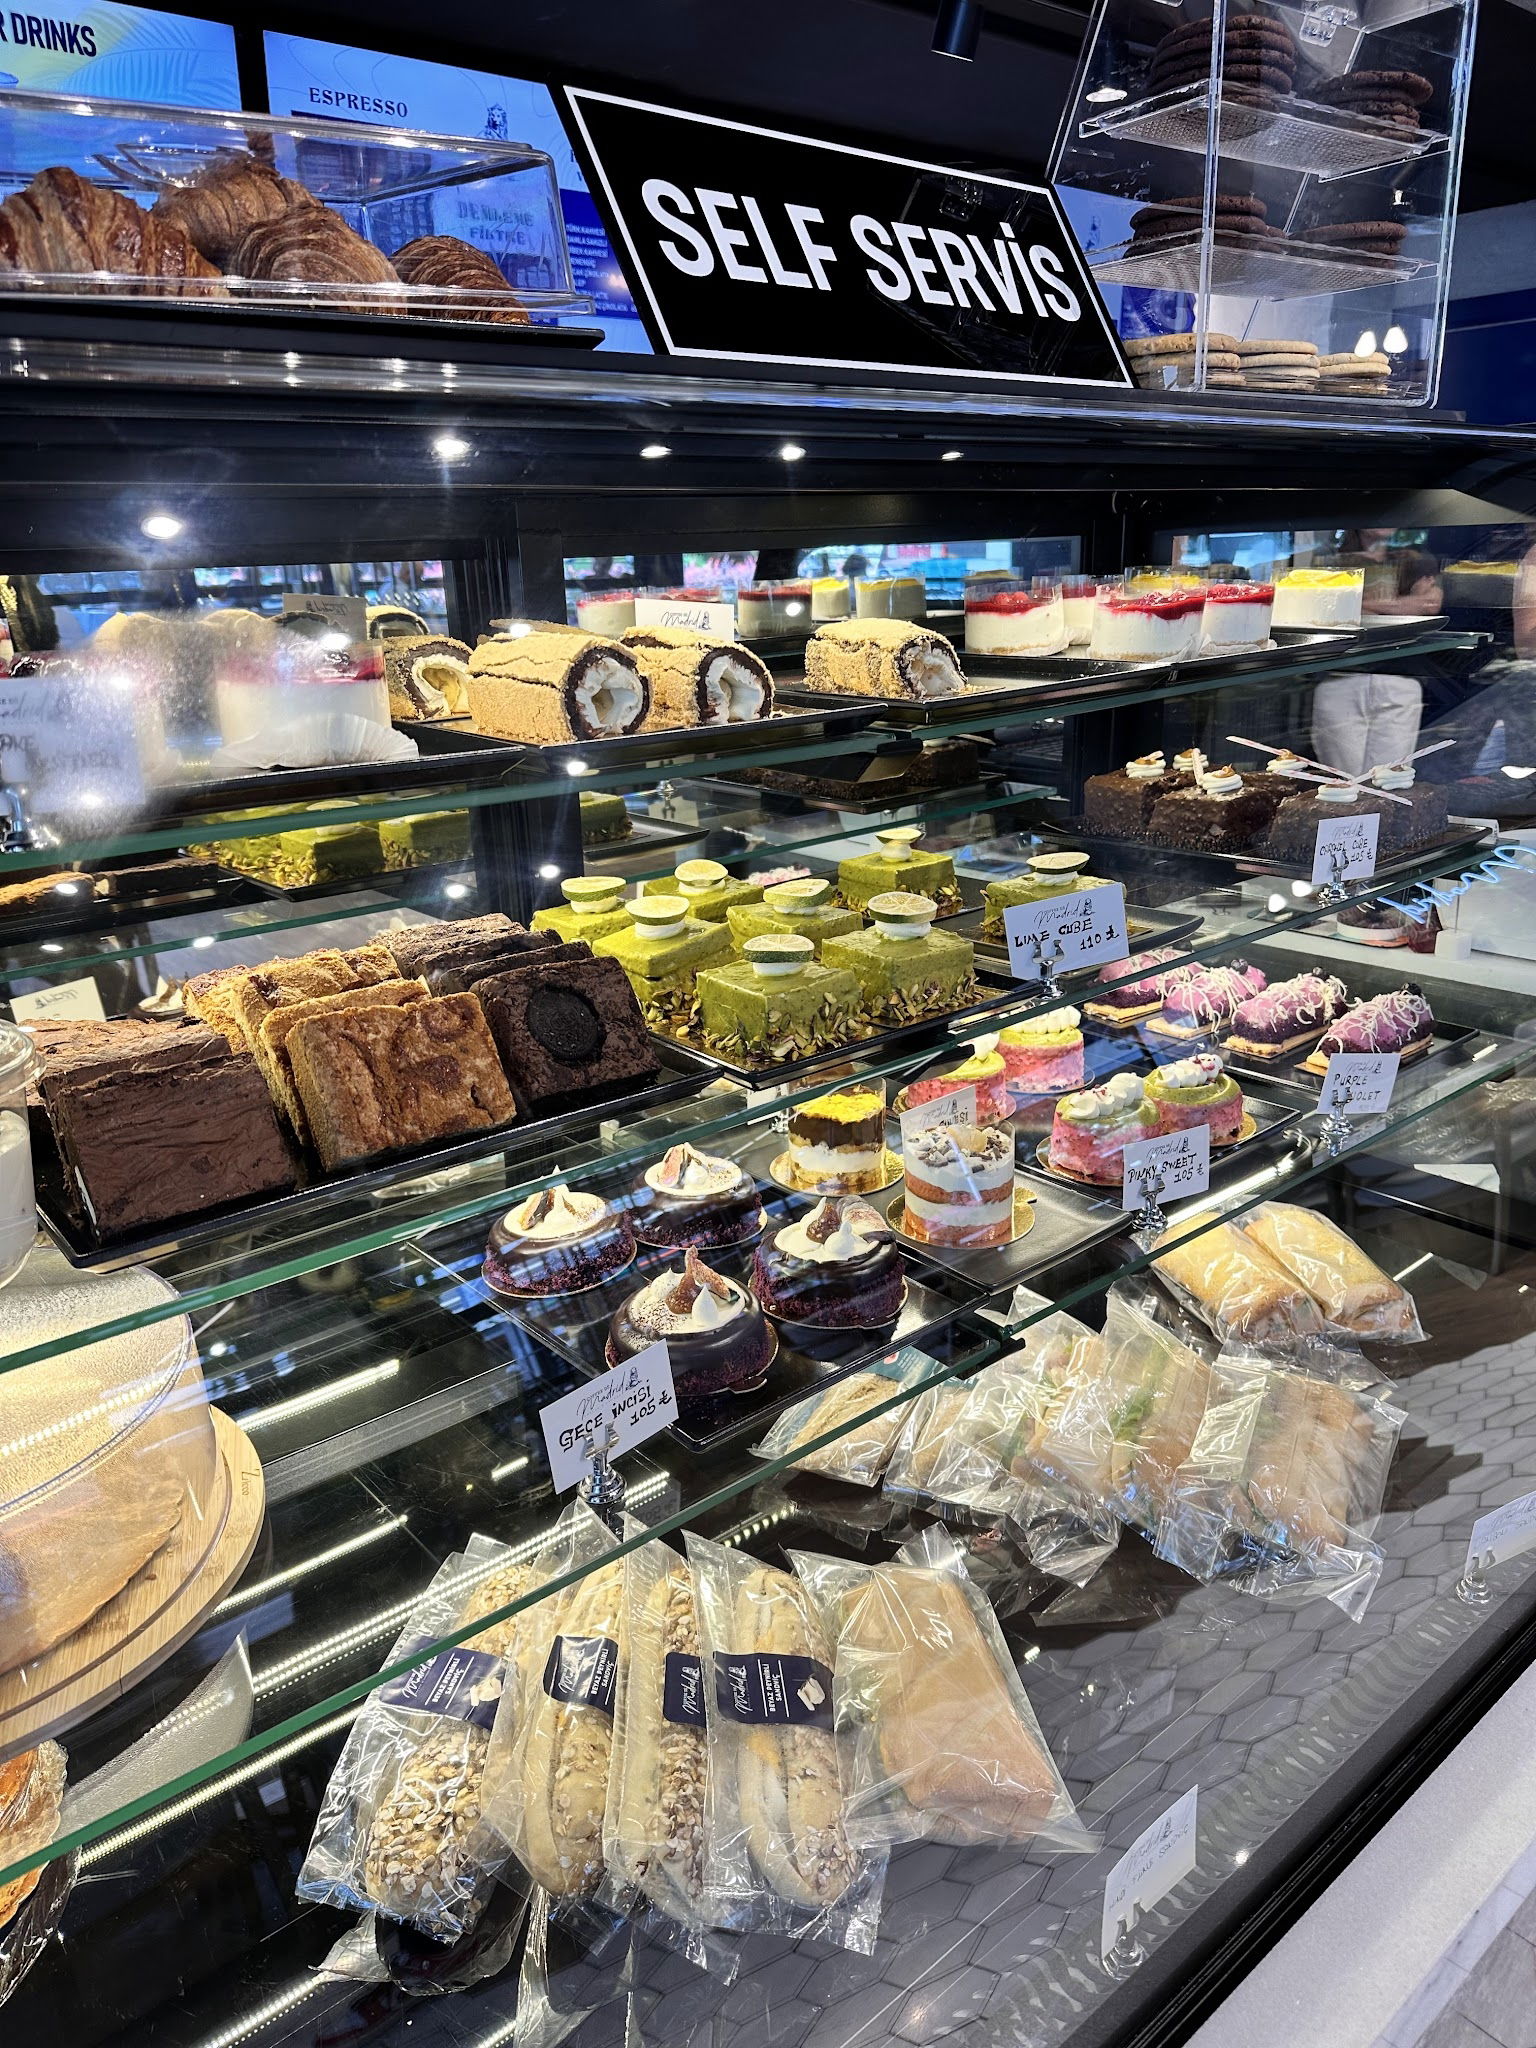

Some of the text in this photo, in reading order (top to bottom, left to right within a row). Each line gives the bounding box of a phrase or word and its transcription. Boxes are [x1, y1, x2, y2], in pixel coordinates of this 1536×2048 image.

[10, 12, 97, 57] DRINKS
[309, 87, 408, 118] ESPRESSO
[641, 178, 1081, 322] SELF SERVİS
[1034, 899, 1081, 929] Madrid
[1014, 918, 1093, 947] LIME CUBE
[1080, 934, 1102, 950] 110
[1334, 1073, 1368, 1086] PURPLE
[1128, 1153, 1197, 1183] PINKY SWEET
[1173, 1166, 1194, 1183] 105
[577, 1371, 625, 1420] Madrid
[630, 1398, 656, 1426] 105
[559, 1413, 603, 1453] GECE
[681, 1674, 700, 1714] Madrid
[728, 1673, 753, 1714] Madrid
[768, 1691, 776, 1712] BEYAZ
